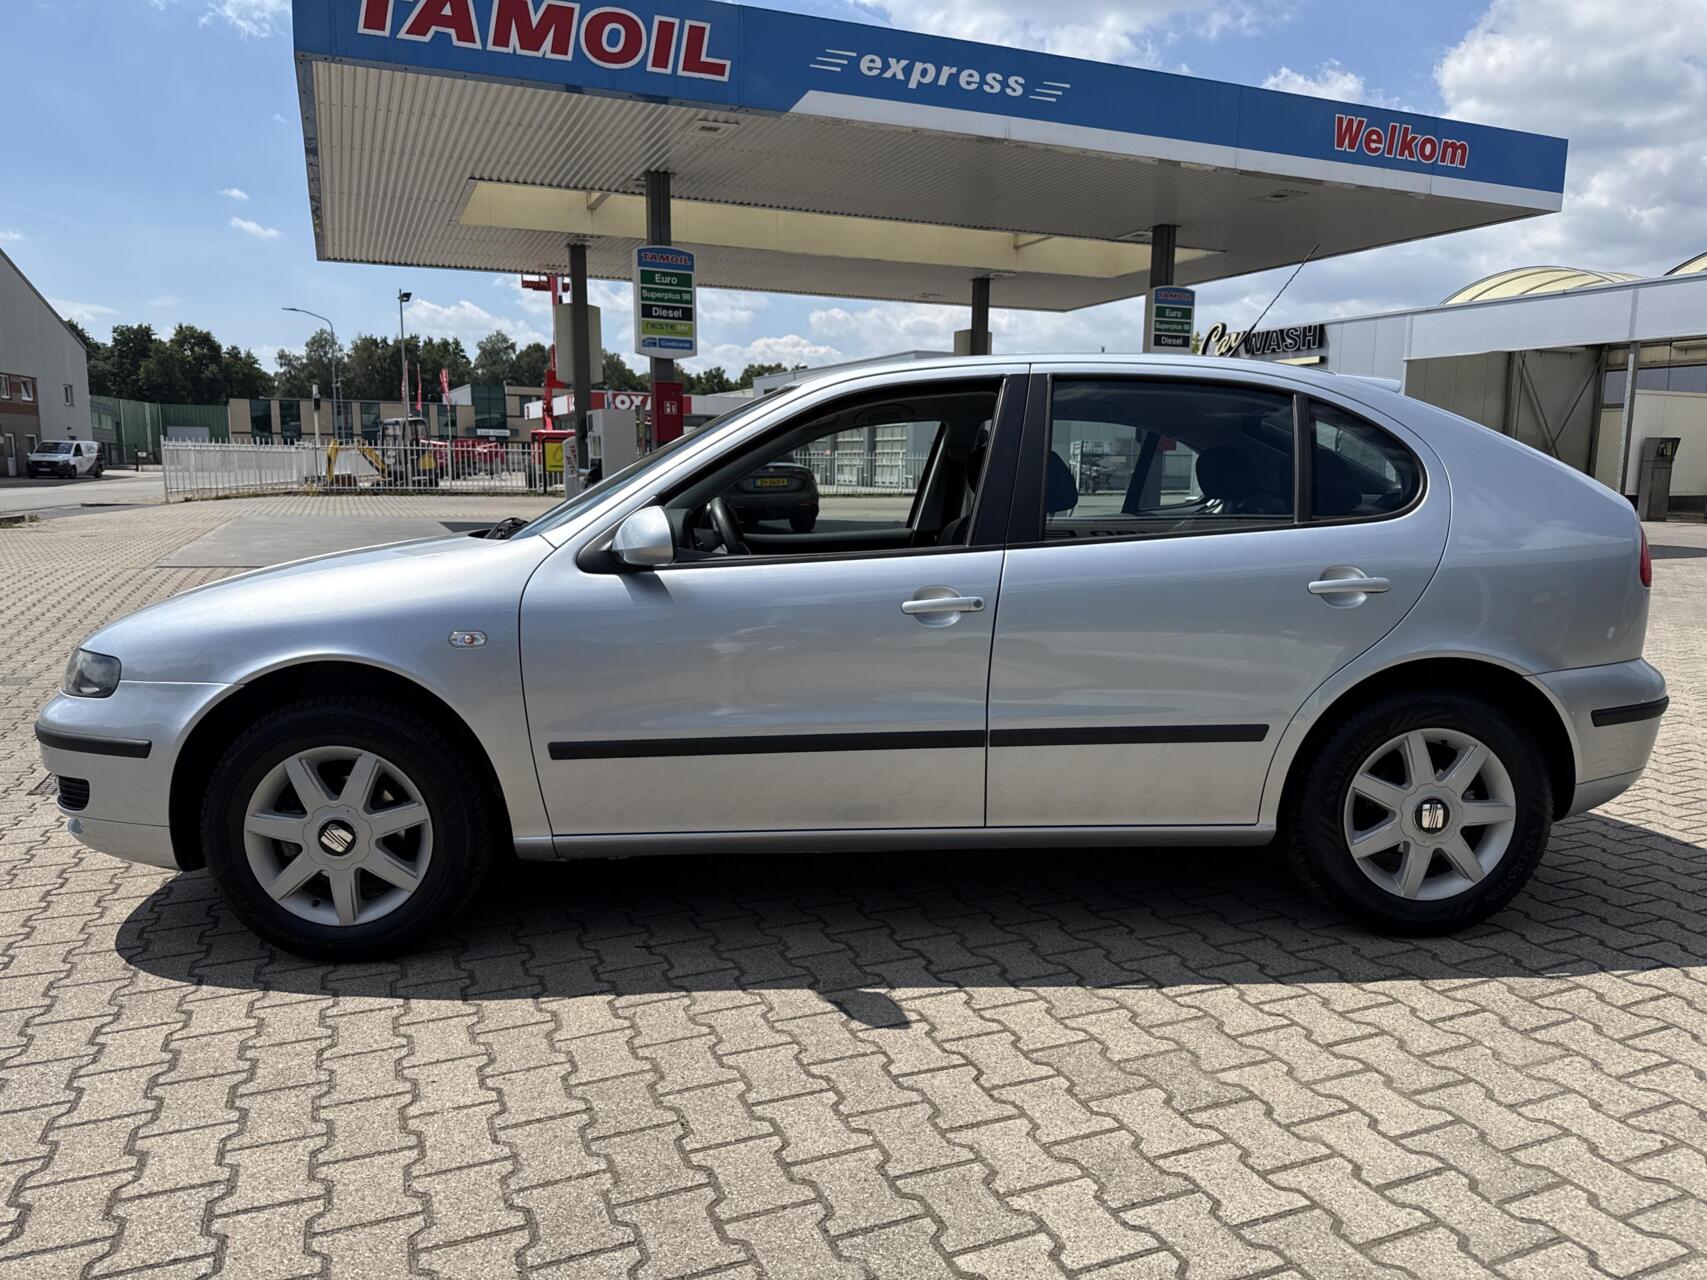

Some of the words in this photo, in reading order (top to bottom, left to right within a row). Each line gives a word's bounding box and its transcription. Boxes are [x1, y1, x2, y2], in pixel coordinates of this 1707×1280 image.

[357, 0, 731, 82] TAMOIL
[859, 53, 1026, 97] express
[1335, 114, 1469, 168] Welkom
[642, 252, 691, 265] TAMOIL
[655, 273, 678, 284] Euro
[642, 289, 680, 300] Superplus
[682, 292, 691, 301] 98
[652, 306, 682, 318] Diesel
[1165, 308, 1182, 318] Euro
[1161, 335, 1183, 346] Diesel
[1245, 324, 1324, 355] WASH
